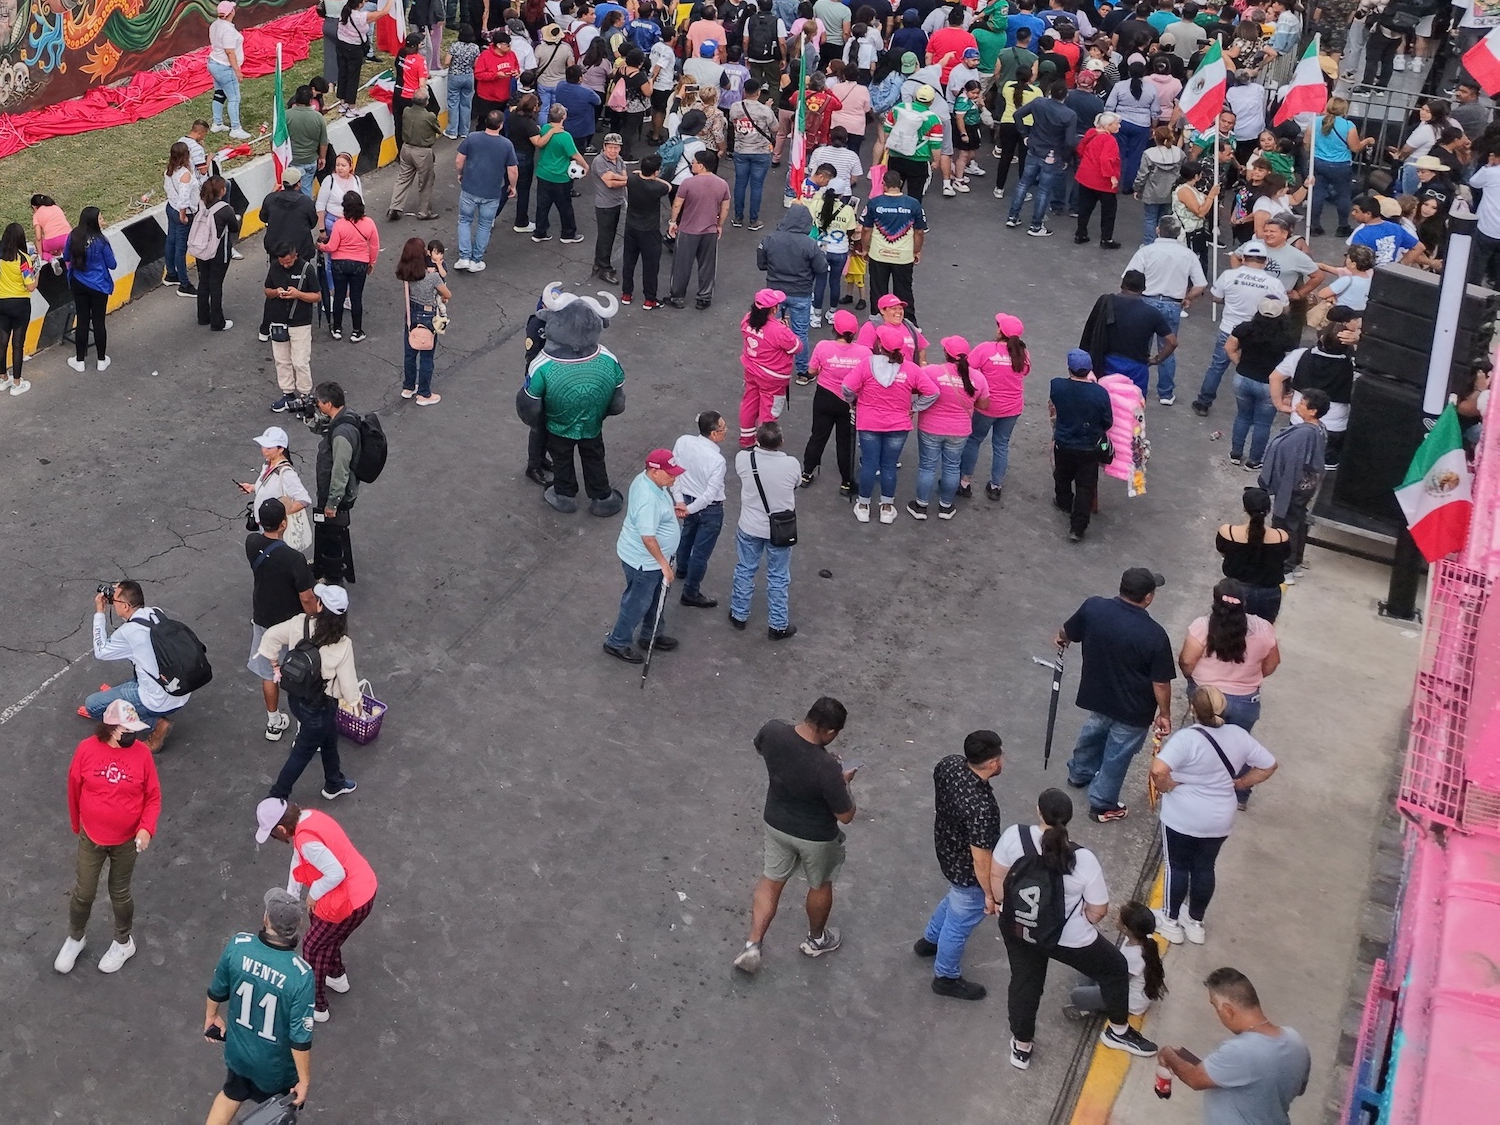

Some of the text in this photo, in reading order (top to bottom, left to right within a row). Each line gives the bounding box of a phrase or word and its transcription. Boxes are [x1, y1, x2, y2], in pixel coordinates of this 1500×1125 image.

[876, 206, 912, 214] Corona Cero
[1243, 273, 1267, 283] telcel
[1241, 280, 1269, 289] SUZUKI
[242, 955, 288, 990] WENTZ
[235, 980, 278, 1042] 11
